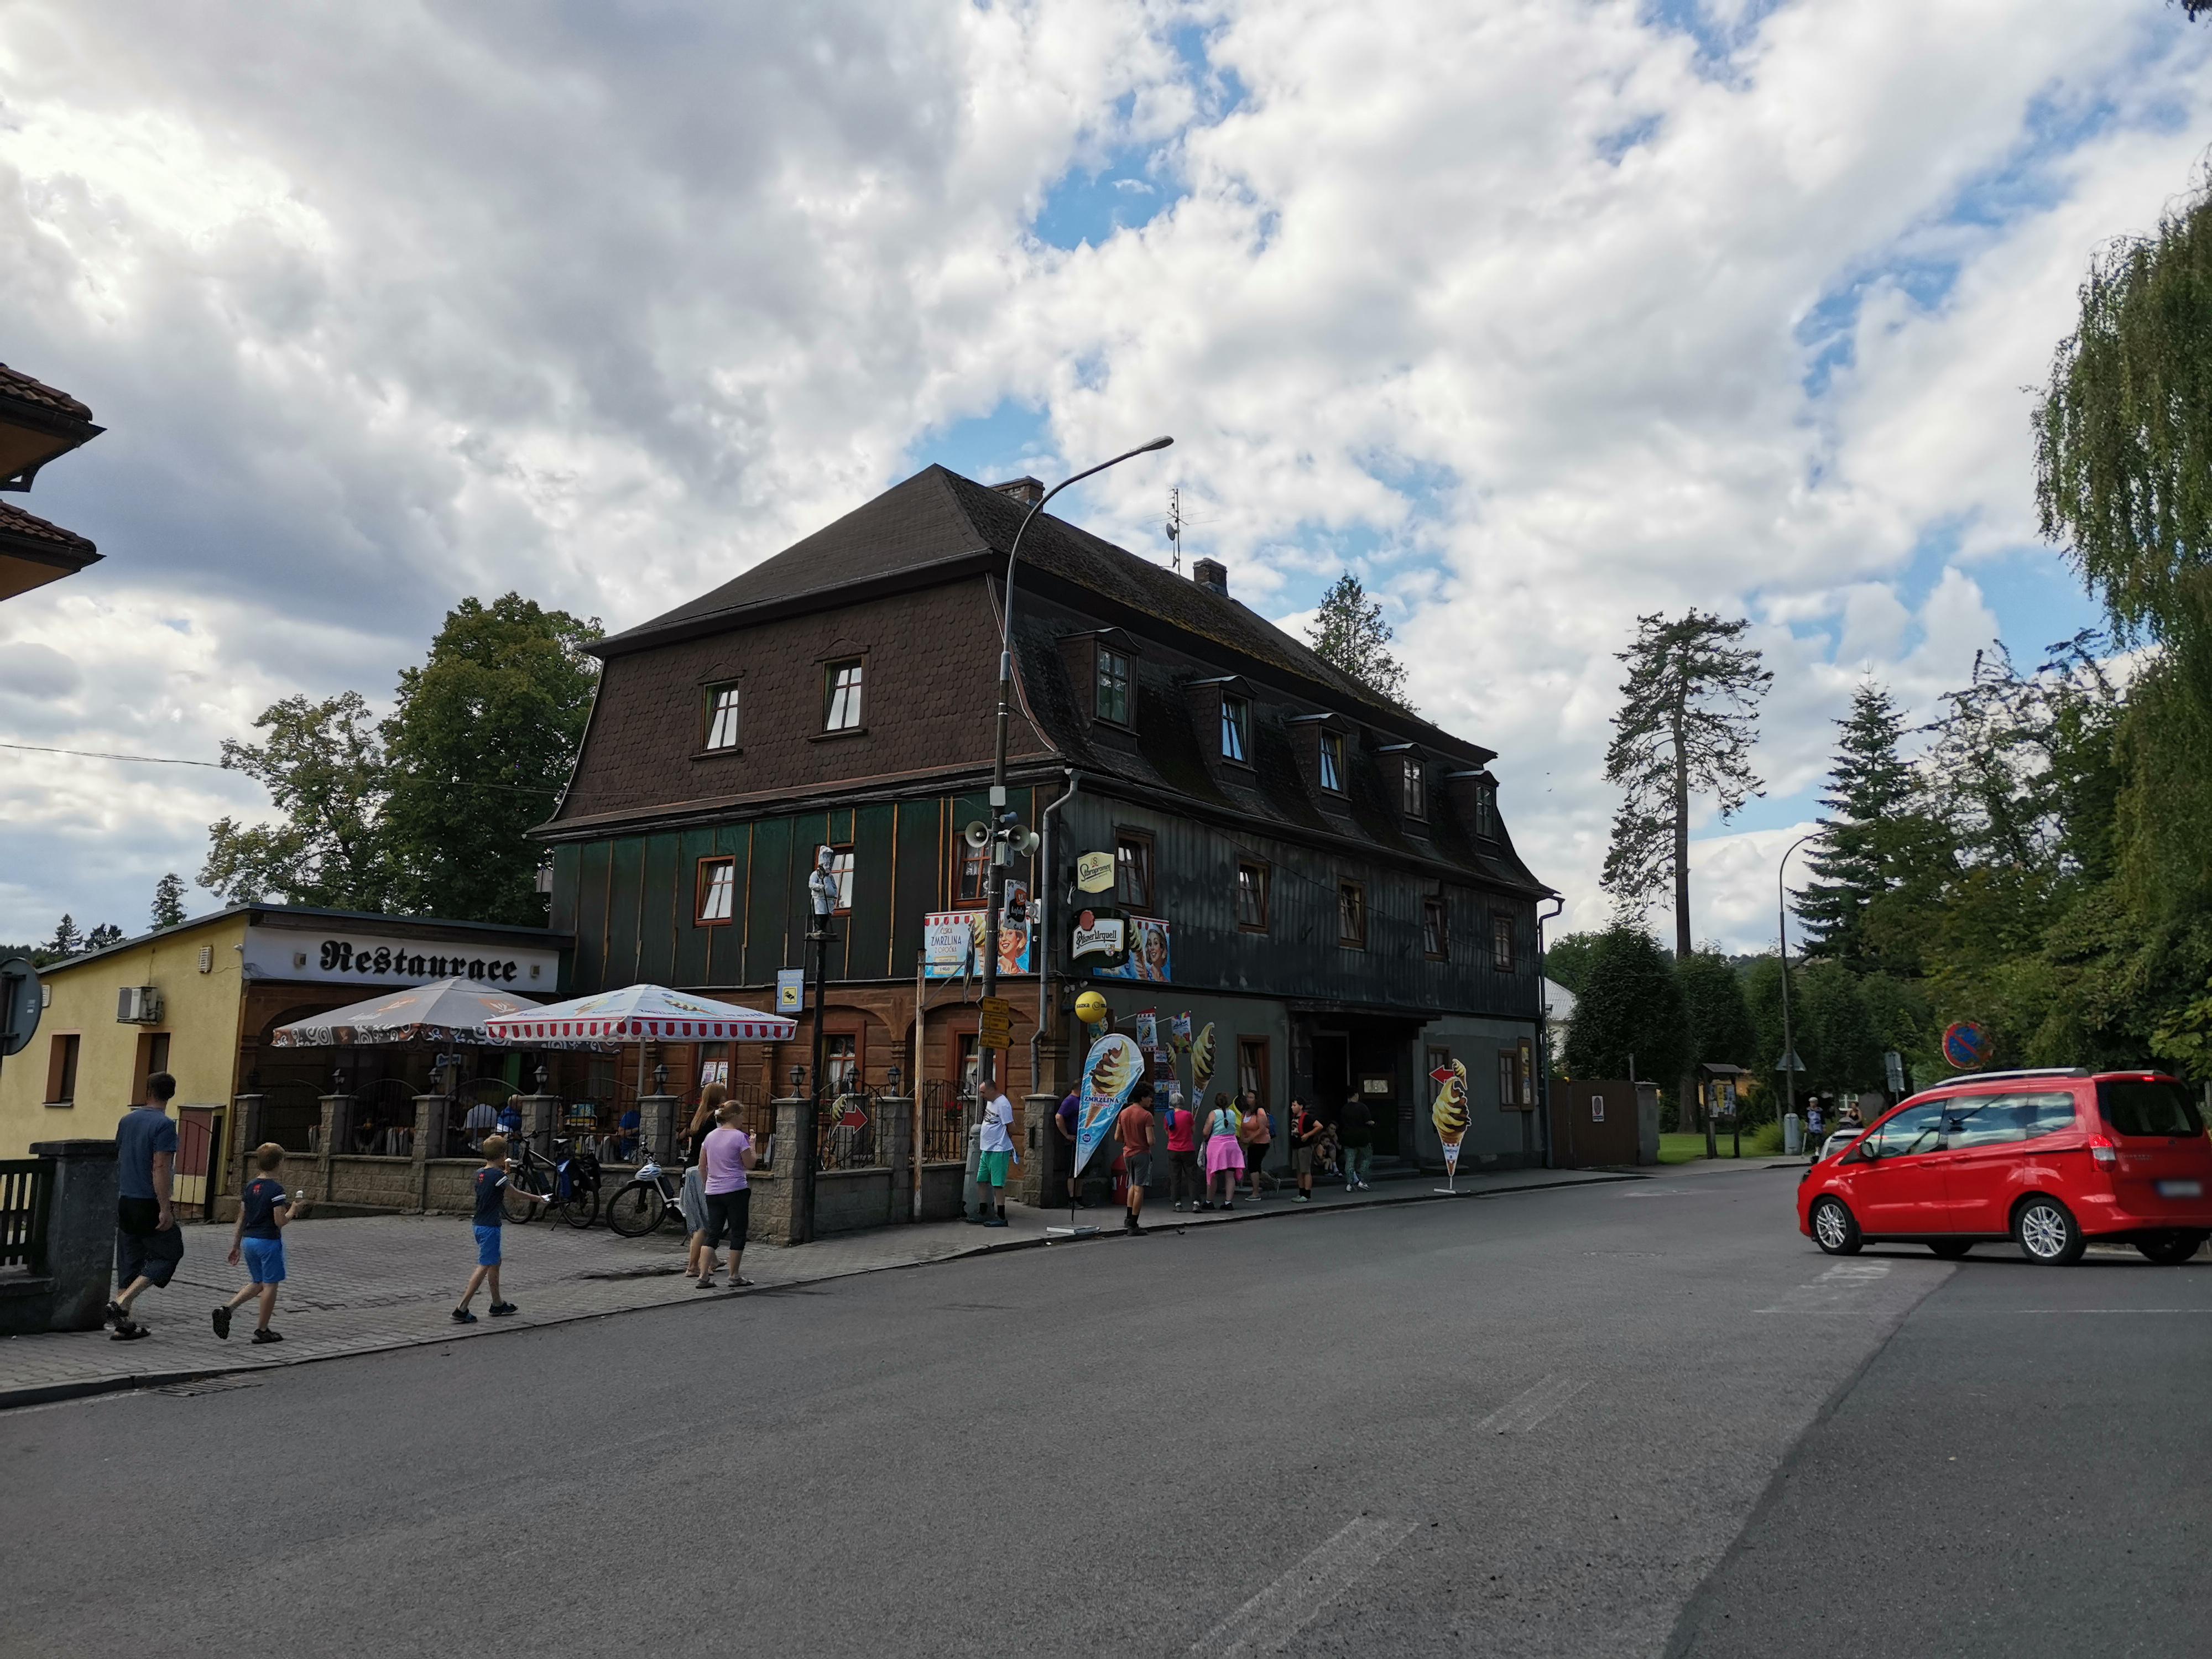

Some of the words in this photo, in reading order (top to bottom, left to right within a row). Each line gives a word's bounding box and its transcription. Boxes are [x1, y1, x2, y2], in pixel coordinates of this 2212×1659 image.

[1080, 863, 1112, 881] Staropramen
[931, 935, 962, 946] ZMRZLINA
[1076, 931, 1095, 949] Pilsner
[1094, 930, 1117, 943] Urquell
[320, 940, 517, 982] Restaurace
